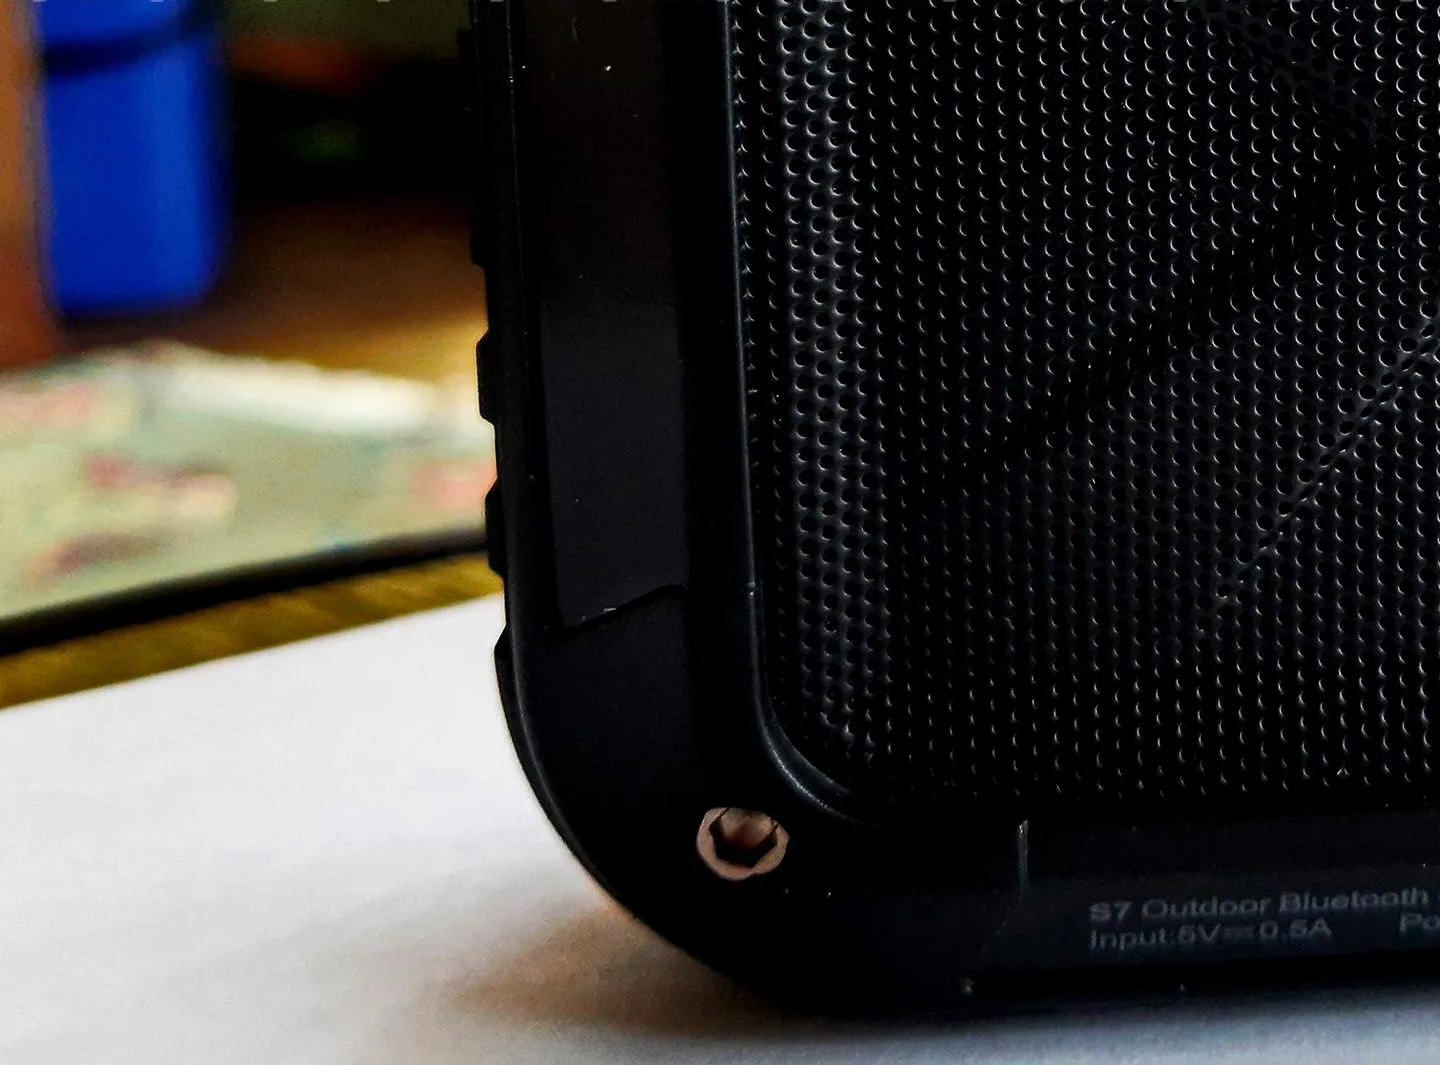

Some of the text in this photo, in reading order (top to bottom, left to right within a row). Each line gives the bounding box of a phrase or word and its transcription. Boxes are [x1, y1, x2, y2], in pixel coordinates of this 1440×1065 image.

[1090, 900, 1133, 923] S7
[1142, 896, 1272, 920] Outdoor
[1279, 886, 1430, 913] Bluetooth
